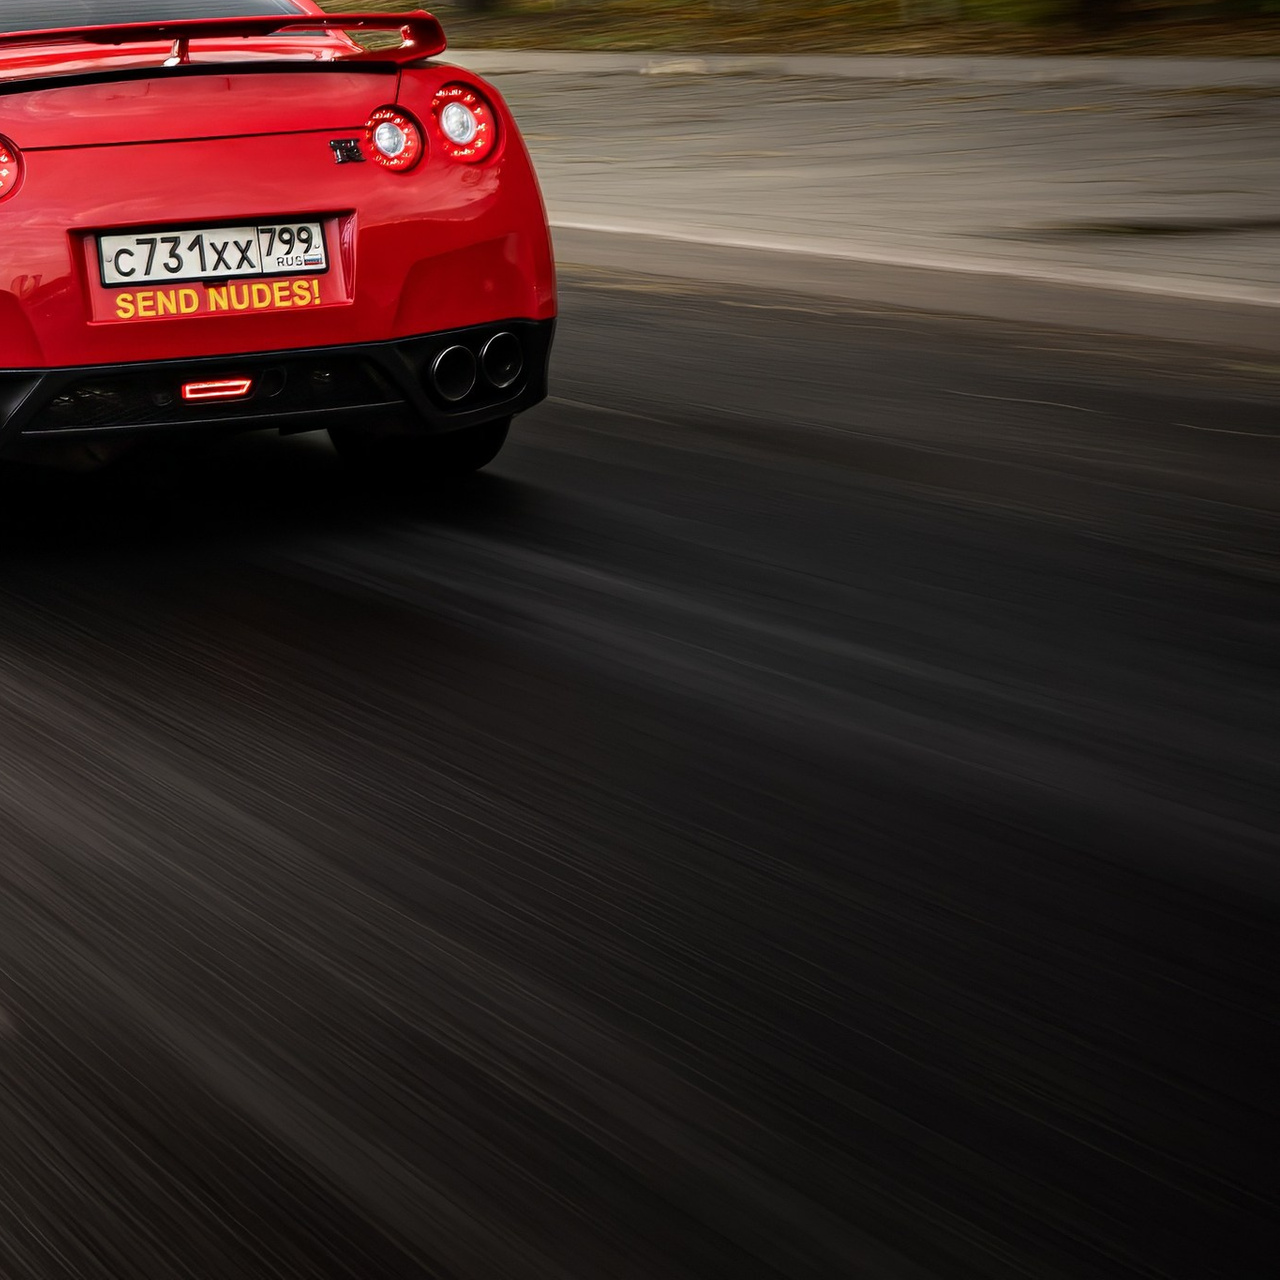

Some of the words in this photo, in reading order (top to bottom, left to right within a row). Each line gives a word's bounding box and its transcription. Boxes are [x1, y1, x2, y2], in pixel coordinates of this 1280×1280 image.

[259, 225, 314, 257] 799
[276, 256, 303, 268] RUS
[115, 288, 199, 319] SEND
[209, 279, 322, 312] NUDES!
